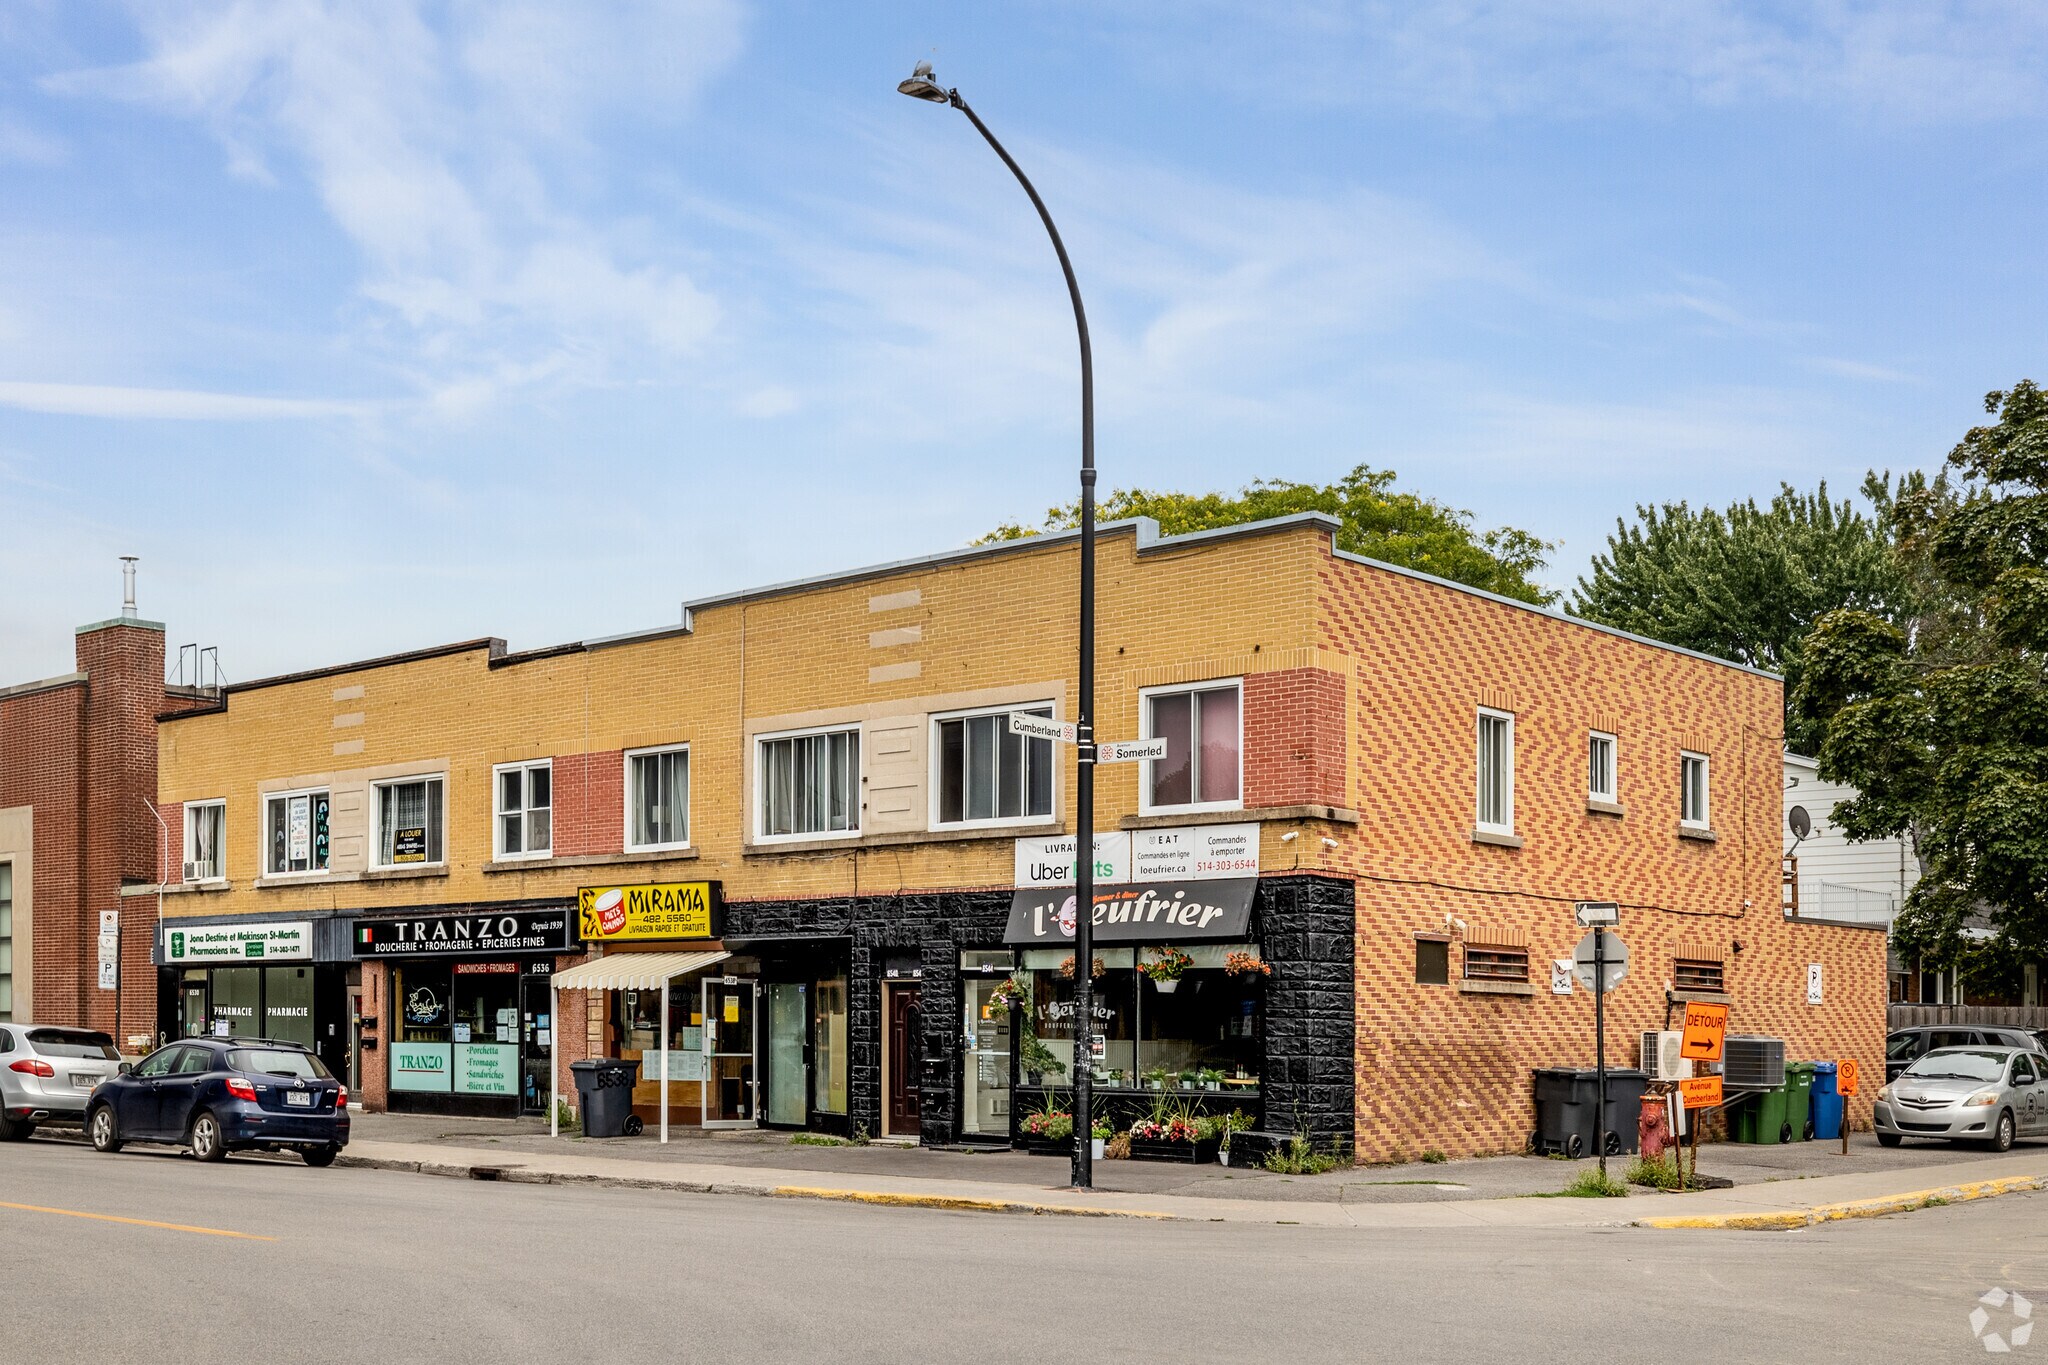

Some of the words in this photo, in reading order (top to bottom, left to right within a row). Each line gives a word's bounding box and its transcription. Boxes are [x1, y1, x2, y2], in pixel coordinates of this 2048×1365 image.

[1013, 720, 1061, 738] Cumberland
[1116, 745, 1162, 759] Somerled
[1208, 835, 1247, 845] Commandes
[1045, 842, 1100, 854] LIVRAIN:
[1216, 847, 1245, 857] emporter
[1137, 852, 1169, 860] Commandes
[1177, 850, 1190, 860] ligne
[1031, 862, 1069, 881] Uber
[1073, 860, 1113, 879] ts
[1140, 865, 1186, 874] loeufrier.ca
[1197, 860, 1256, 871] 514-303-6544
[629, 888, 705, 914] MIRAMA
[604, 906, 621, 920] METS
[643, 914, 692, 923] 482.5560
[531, 921, 549, 933] Depuis
[550, 920, 563, 930] 1939
[602, 914, 625, 930] CHINOIS
[395, 917, 518, 941] TRANZO
[629, 924, 654, 933] LIVRAISON
[655, 924, 672, 933] RAPIDE
[674, 924, 680, 932] ET
[682, 923, 706, 932] GRATUITE
[190, 933, 204, 943] Jona
[230, 933, 236, 942] et
[237, 931, 268, 941] Makinson
[270, 929, 300, 940] St-Martin
[375, 942, 417, 952] BOUCHERIE
[425, 940, 473, 951] FROMAGERIE
[482, 937, 521, 948] EPICERIES
[523, 936, 545, 947] FINES
[190, 946, 228, 955] Pharmaciens
[230, 945, 241, 955] inc.
[457, 964, 487, 973] SANDWICHES
[490, 963, 515, 973] FROMAGES
[532, 963, 550, 973] 6536
[214, 1007, 252, 1017] PHARMACIE
[267, 1007, 308, 1017] PHARMACIE
[1687, 1012, 1723, 1029] DÉTOUR
[469, 1045, 499, 1055] Porchetta
[400, 1055, 443, 1069] TRANZO
[469, 1058, 499, 1070] Fromages
[469, 1069, 504, 1079] Sandwiches
[597, 1071, 629, 1088] 6538
[486, 1083, 492, 1091] et
[493, 1083, 505, 1091] Vin
[1689, 1083, 1712, 1091] Avenue
